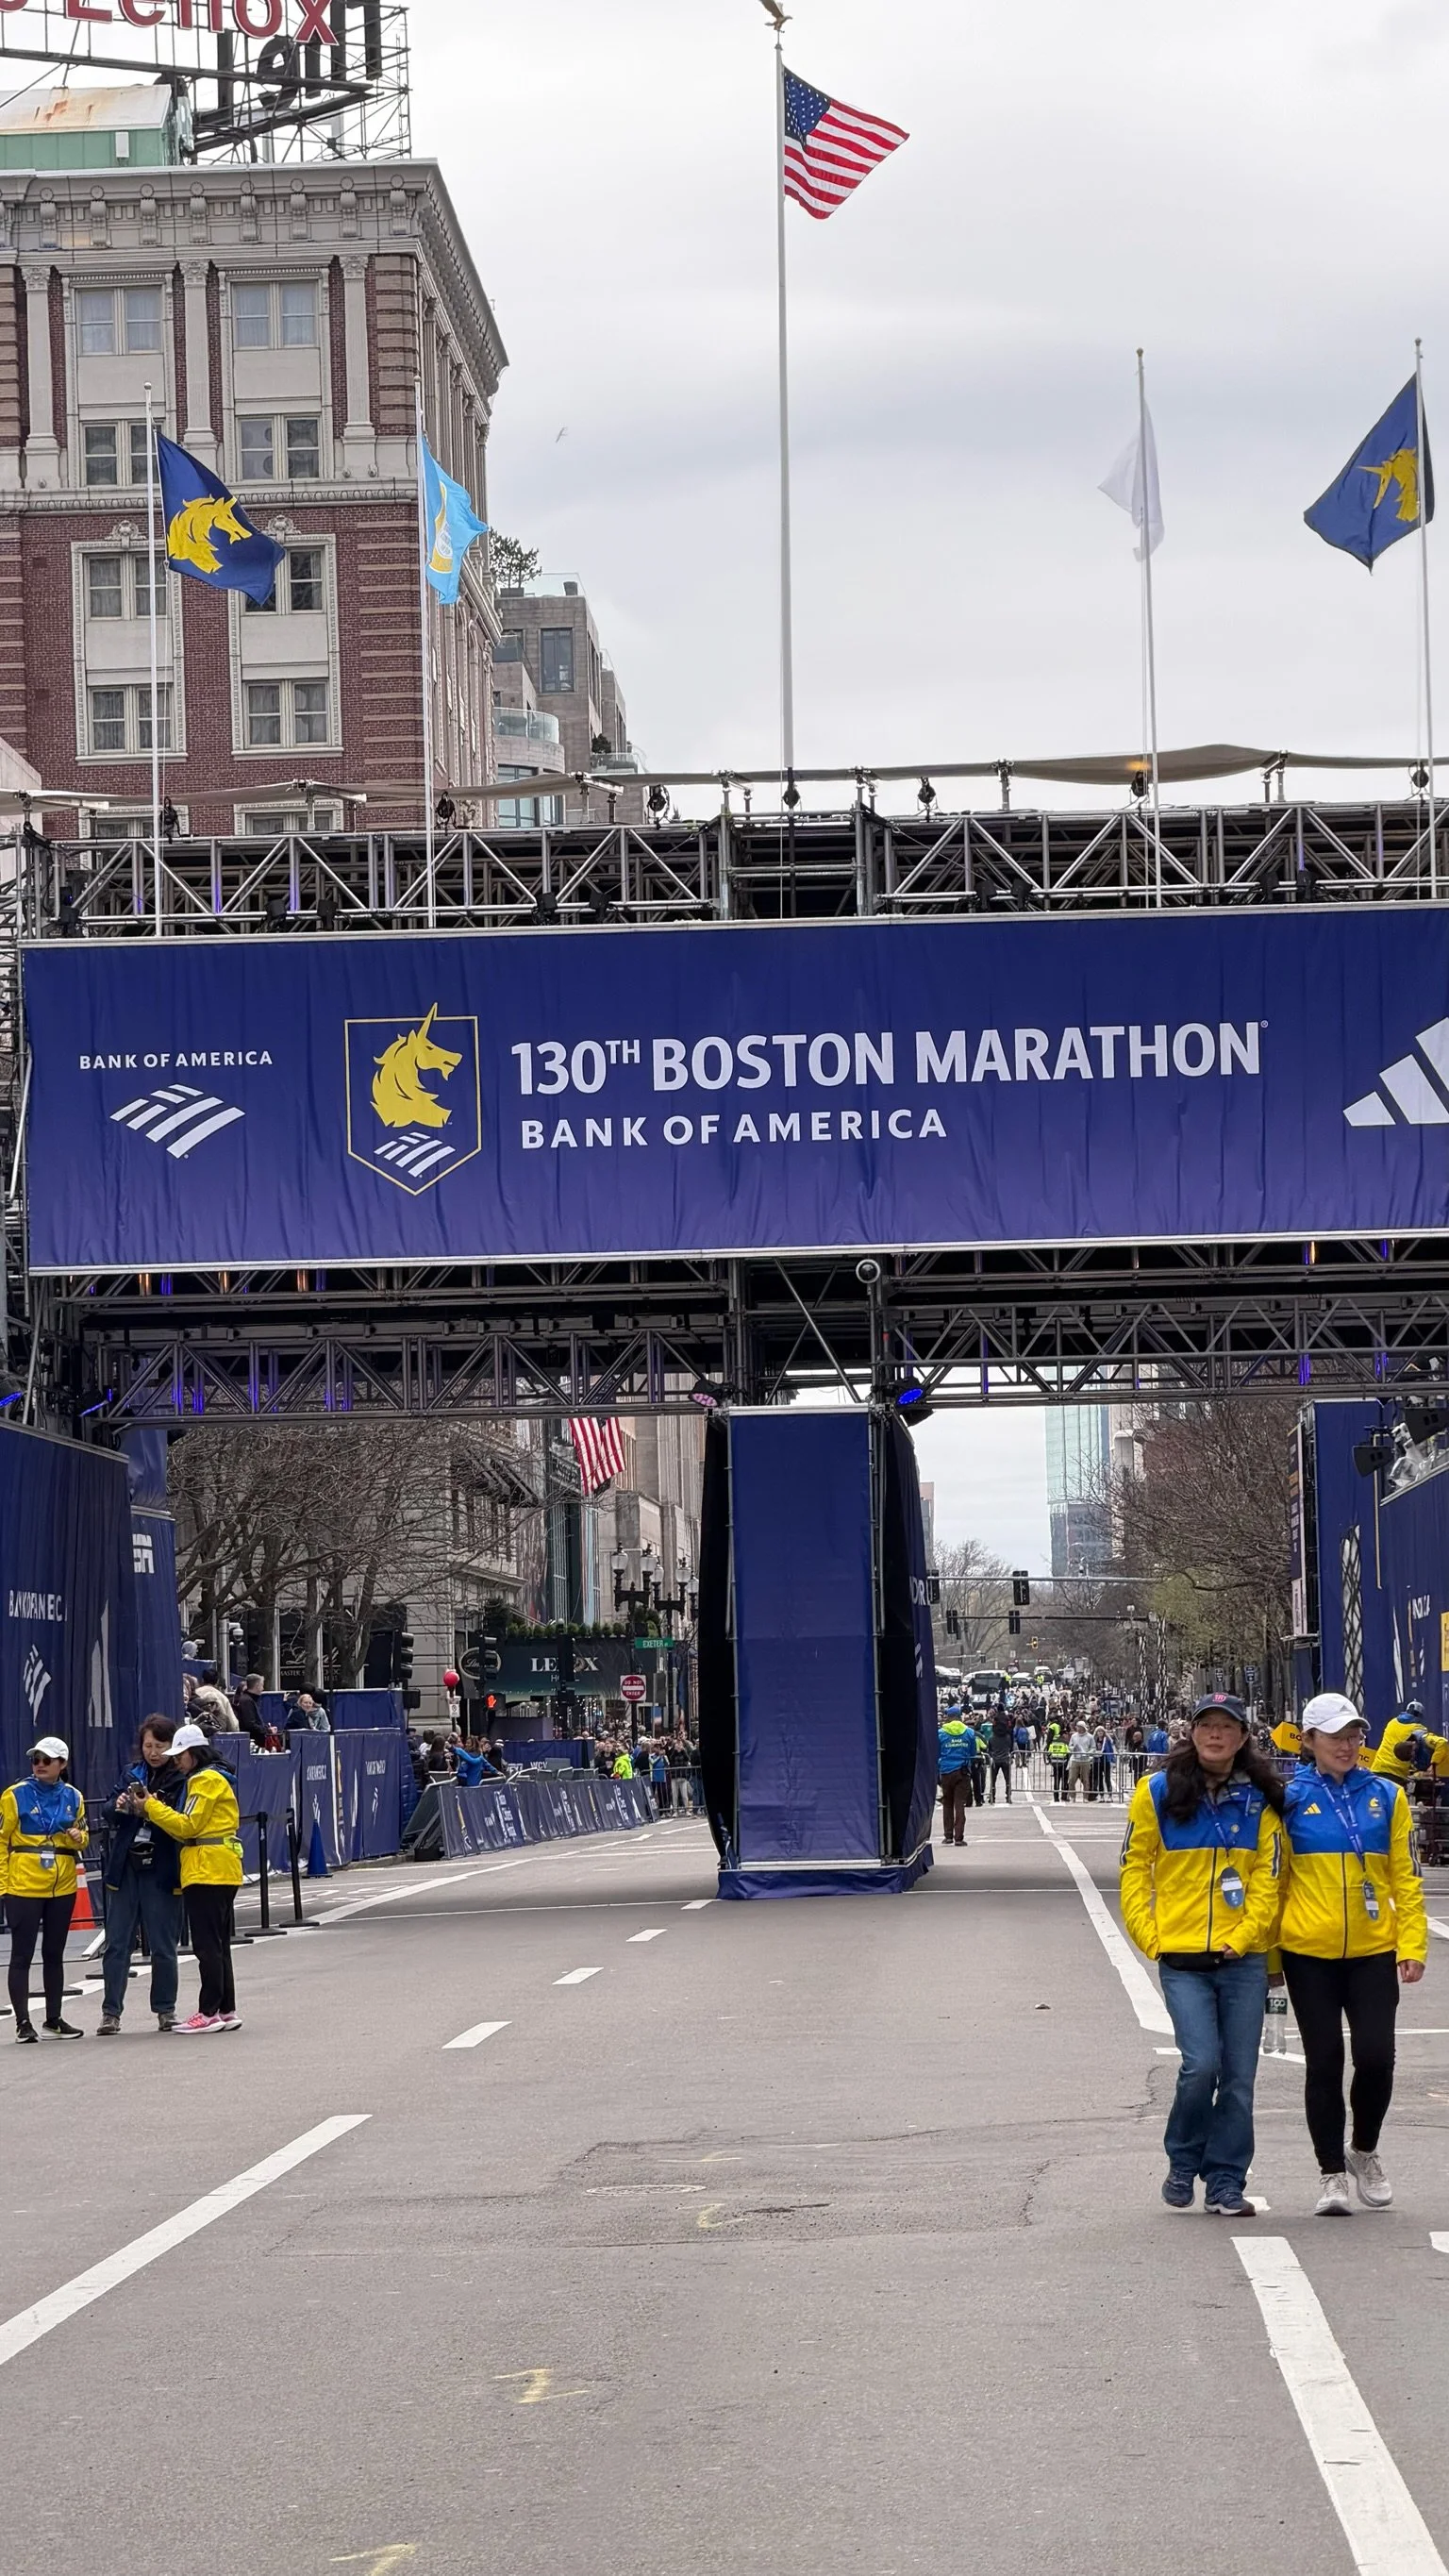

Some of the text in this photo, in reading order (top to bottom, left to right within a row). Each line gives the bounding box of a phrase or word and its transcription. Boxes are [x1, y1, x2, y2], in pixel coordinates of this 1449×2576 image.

[79, 1050, 273, 1070] BANK OF AMERICA
[510, 1039, 641, 1095] 130TH
[652, 1032, 894, 1091] BOSTON
[521, 1109, 947, 1149] BANK OF AMERICA
[642, 1640, 664, 1648] EXETER
[530, 1657, 599, 1672] LEOX
